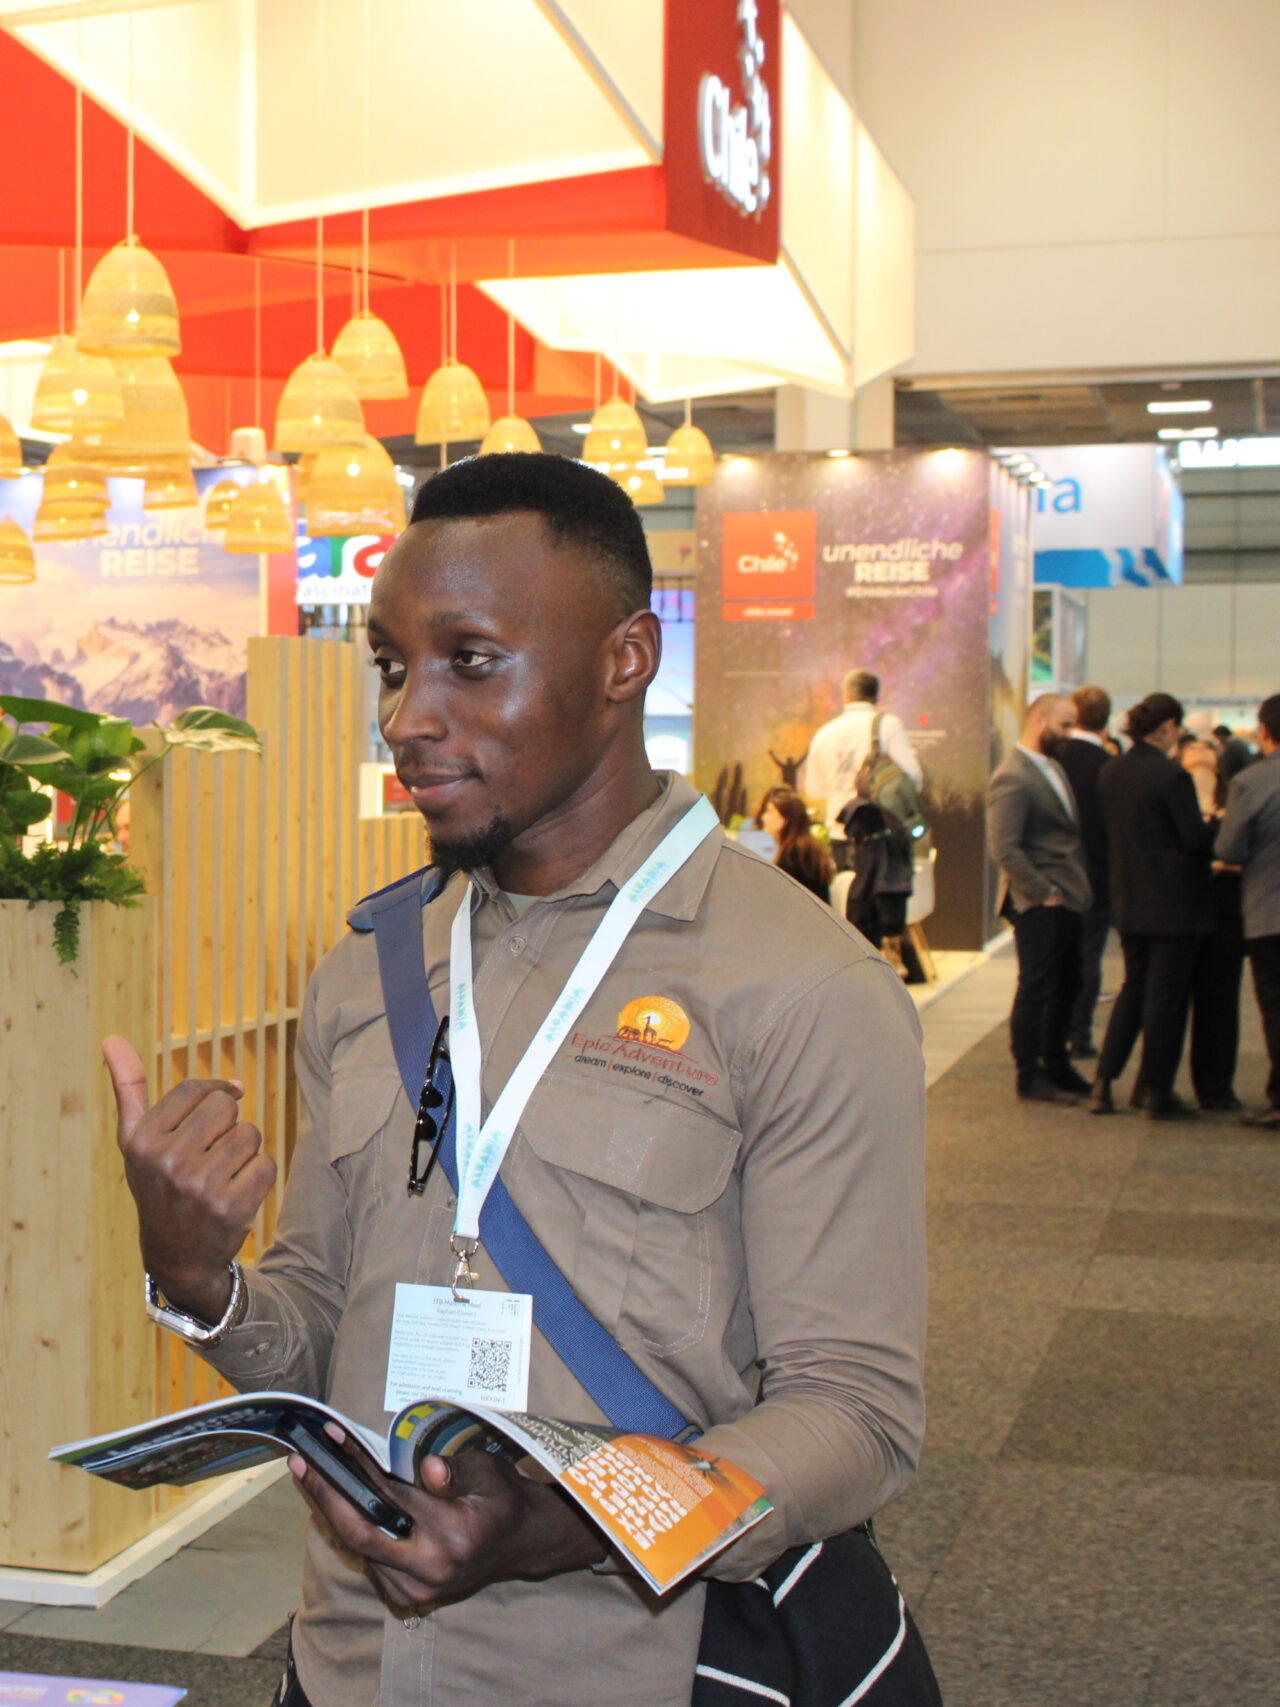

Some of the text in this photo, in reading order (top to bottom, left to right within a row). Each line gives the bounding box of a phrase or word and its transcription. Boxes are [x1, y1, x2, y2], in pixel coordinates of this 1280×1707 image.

[697, 74, 758, 213] Chile
[100, 549, 200, 577] REISE
[737, 554, 788, 574] Chile
[822, 538, 965, 563] unendliche
[854, 561, 931, 583] REISE
[571, 1032, 611, 1054] Epic
[574, 1054, 705, 1098] dream explore discover
[608, 1491, 657, 1545] THE
[609, 1480, 667, 1533] AND
